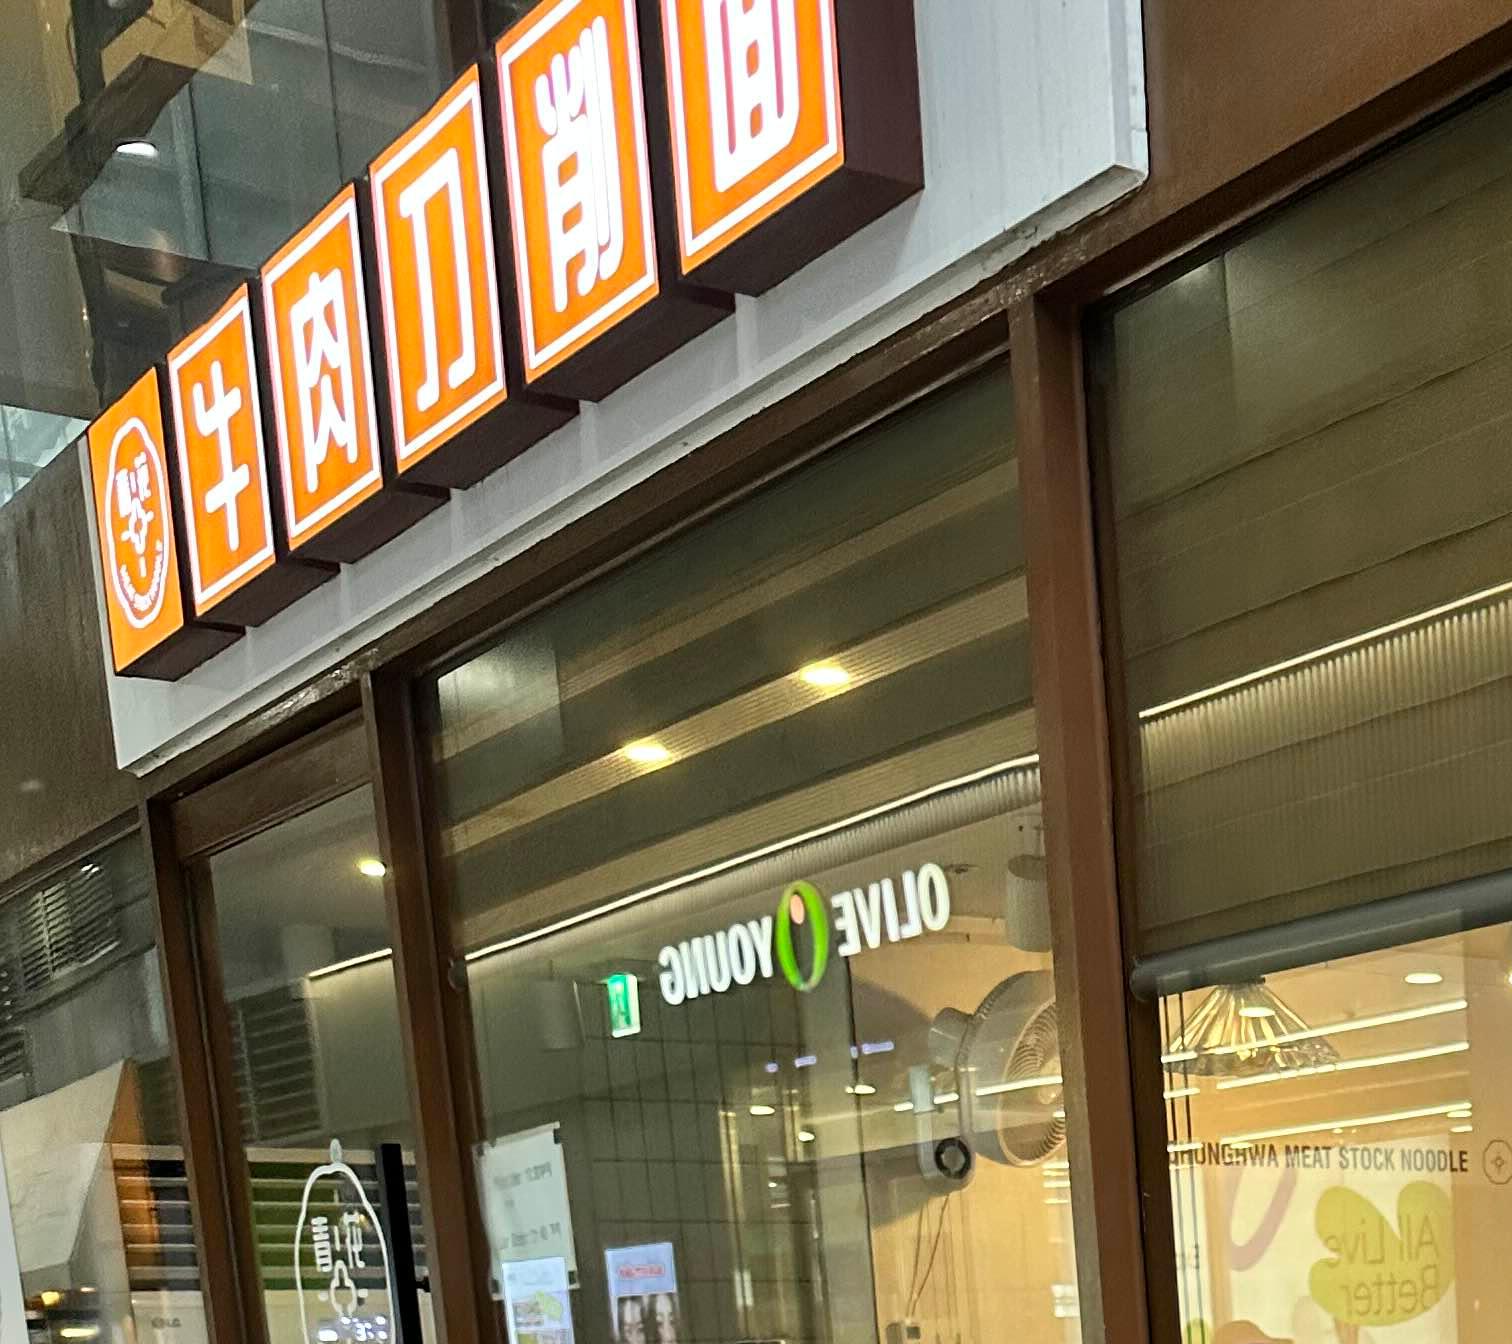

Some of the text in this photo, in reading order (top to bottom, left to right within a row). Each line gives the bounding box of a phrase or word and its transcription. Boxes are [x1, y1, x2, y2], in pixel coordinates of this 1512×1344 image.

[1285, 1146, 1332, 1169] MEAT
[1339, 1146, 1396, 1171] STOCK
[1401, 1149, 1469, 1173] NOODLE
